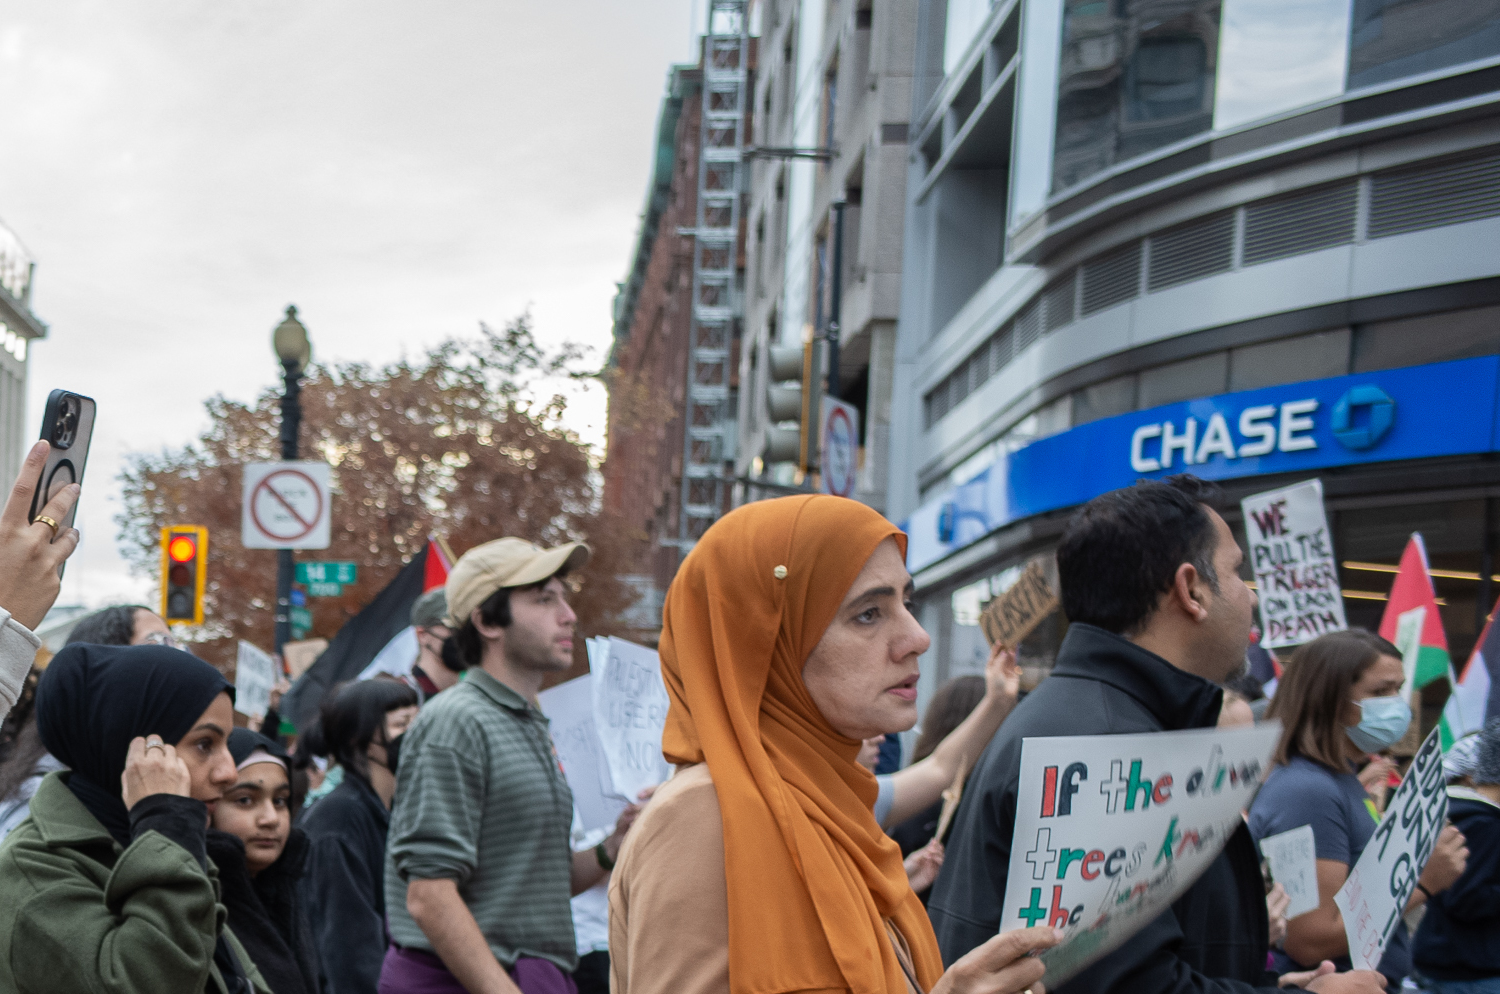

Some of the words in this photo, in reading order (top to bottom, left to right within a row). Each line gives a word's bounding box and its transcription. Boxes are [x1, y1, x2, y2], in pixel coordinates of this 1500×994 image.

[1131, 398, 1319, 473] CHASE
[1250, 499, 1290, 539] WE
[1255, 541, 1299, 568] PULL
[1296, 528, 1331, 561] THE
[1265, 597, 1289, 615] ON
[1293, 591, 1336, 612] EACH
[1268, 610, 1340, 641] DEATH
[1039, 761, 1088, 818] If
[1100, 758, 1173, 815] the
[1026, 827, 1148, 881] trees
[1018, 885, 1085, 929] the
